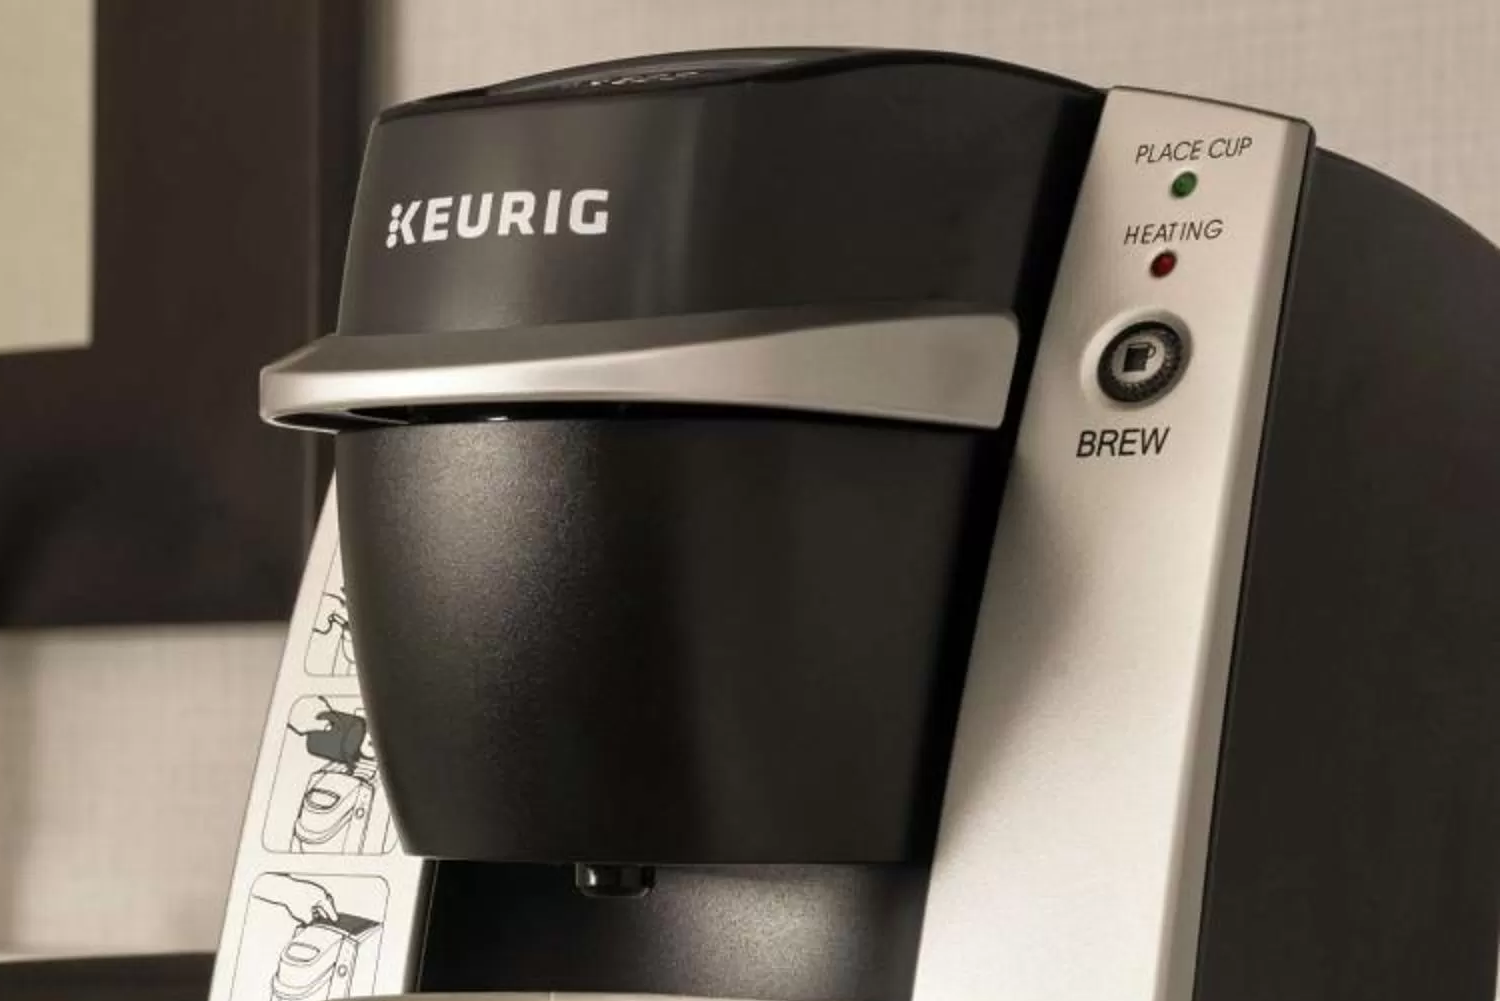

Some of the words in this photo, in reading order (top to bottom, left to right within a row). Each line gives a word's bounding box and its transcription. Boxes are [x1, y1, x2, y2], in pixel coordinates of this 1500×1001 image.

[1134, 139, 1204, 164] PLACE
[1208, 136, 1253, 159] CUP
[386, 189, 609, 249] KEURIG
[1123, 219, 1224, 245] HEATING
[1075, 426, 1171, 459] BREW
